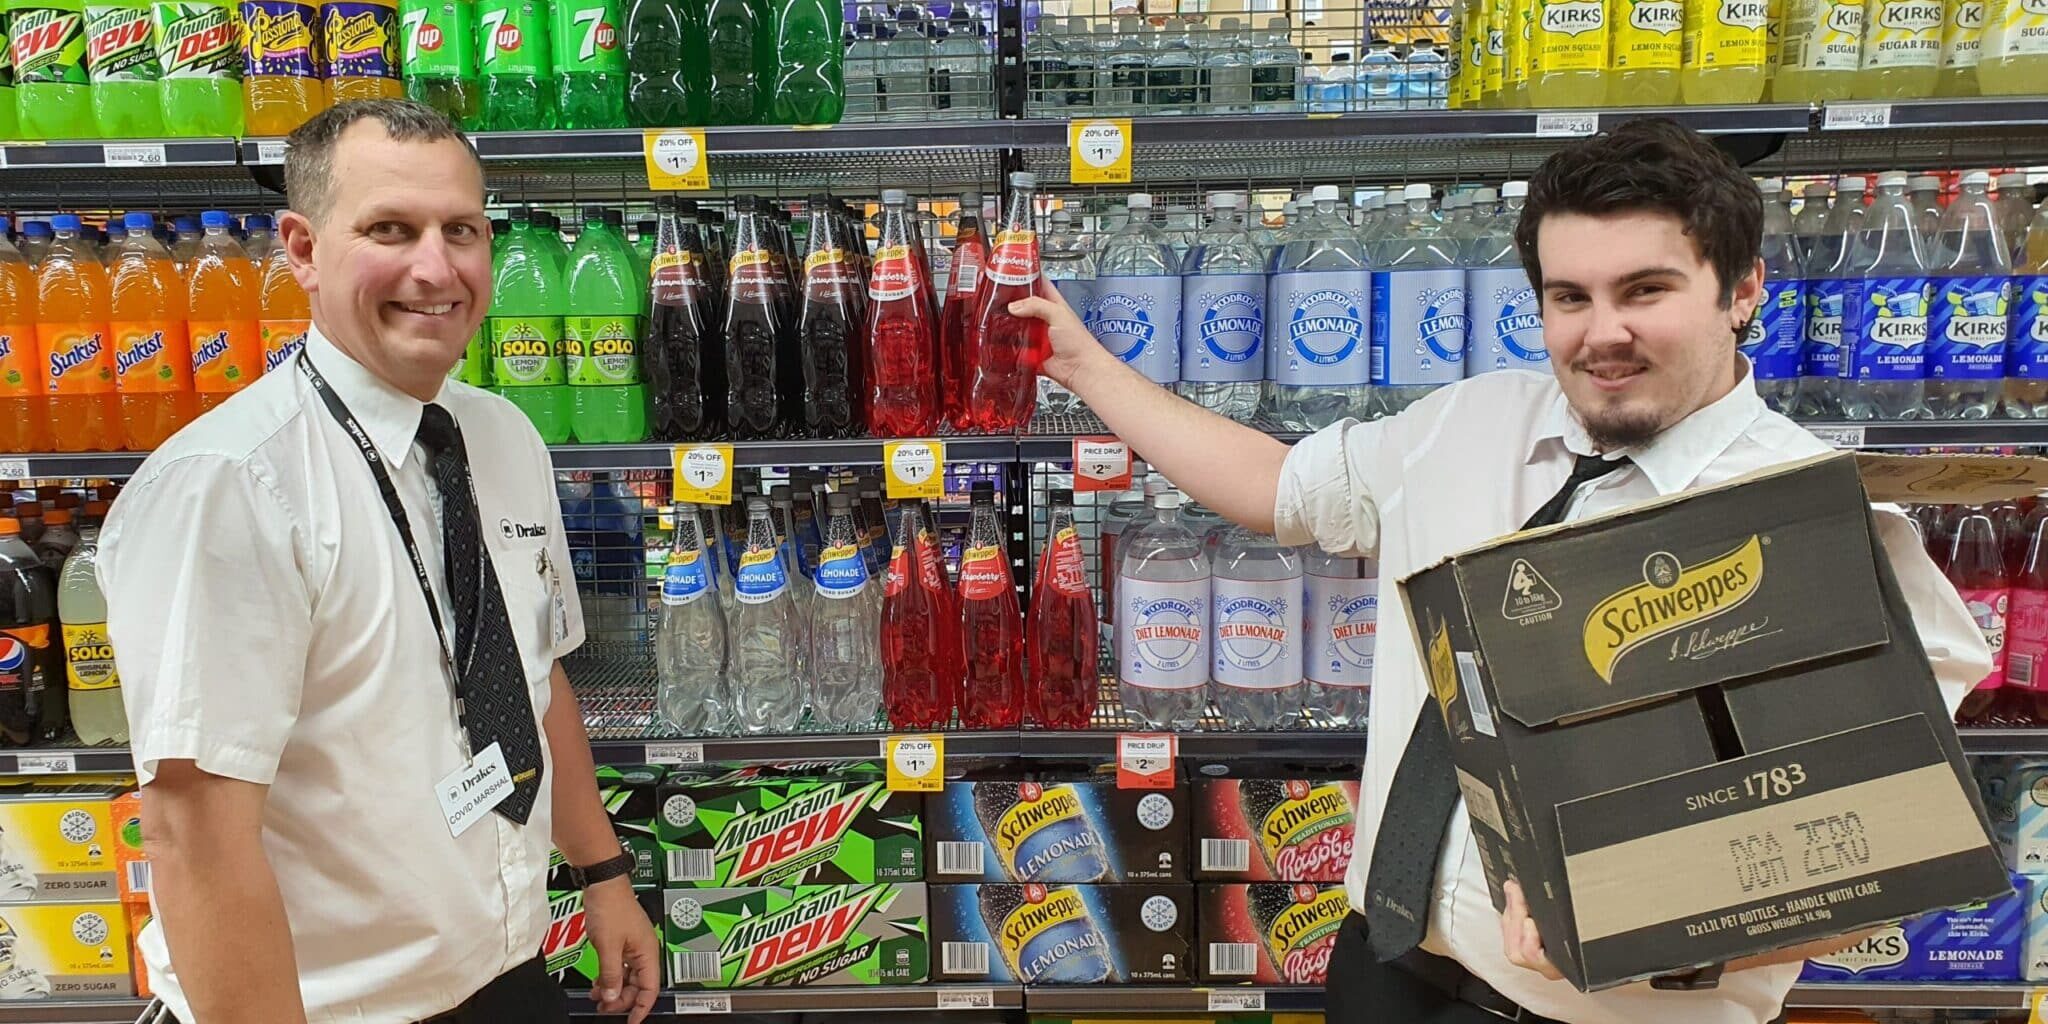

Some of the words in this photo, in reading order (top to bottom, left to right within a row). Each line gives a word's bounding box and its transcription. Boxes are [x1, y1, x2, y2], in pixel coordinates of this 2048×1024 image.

[1547, 7, 1601, 25] KIRKS
[1836, 10, 1863, 25] KIR
[1888, 6, 1941, 21] KIRKS
[252, 9, 302, 54] Passiona
[328, 11, 375, 56] Passiona
[2021, 28, 2048, 38] SUGA
[177, 22, 239, 63] Dew
[1541, 44, 1569, 53] LEMON
[1631, 43, 1659, 51] LEMON
[1879, 41, 1917, 51] SUGAR
[112, 60, 128, 71] NO
[1858, 114, 1884, 123] 2.10
[1085, 130, 1102, 138] 20%
[1103, 129, 1120, 137] OFF
[1569, 122, 1593, 132] 2.10
[659, 139, 676, 147] 20%
[677, 138, 694, 146] OFF
[1210, 294, 1258, 311] WOODROOFE
[1299, 291, 1353, 311] WOODROOFE
[1203, 318, 1263, 336] LEMONADE
[1291, 318, 1360, 336] LEMONADE
[1812, 322, 1841, 337] KIR
[1878, 322, 1927, 337] KIRKS
[1953, 322, 2006, 337] KIRKS
[51, 334, 103, 376] Sunkist
[117, 332, 163, 375] Sunkist
[503, 341, 546, 357] SOLO
[593, 340, 633, 356] SOLO
[511, 358, 540, 366] LEMON
[602, 358, 629, 366] LEMON
[1319, 354, 1339, 364] LITRES
[1877, 356, 1924, 365] LEMONADE
[1951, 354, 2002, 364] LEMONADE
[1835, 434, 1860, 443] 2.10
[688, 453, 704, 461] 20%
[705, 453, 722, 461] OFF
[897, 449, 914, 457] 20%
[915, 448, 930, 456] OFF
[516, 523, 547, 538] Drakes
[738, 573, 777, 583] LEMONADE
[820, 568, 859, 578] LEMONADE
[1143, 599, 1195, 618] WOODROOFE
[1225, 599, 1276, 618] WOODROOFE
[1602, 561, 1748, 649] Schweppes
[1519, 612, 1553, 626] CAUTION
[1136, 627, 1153, 641] DIET
[1154, 625, 1200, 642] LEMONADE
[1220, 626, 1233, 640] DIET
[1235, 624, 1285, 642] LEMONADE
[1333, 627, 1353, 641] DIET
[70, 645, 113, 661] SOLO
[1162, 659, 1180, 669] LITRES
[1242, 659, 1260, 669] LITRES
[900, 742, 916, 751] 20%
[917, 742, 932, 750] OFF
[1127, 742, 1146, 750] PRICE
[1147, 742, 1166, 750] DROP
[677, 750, 698, 760] 2.20
[461, 760, 497, 793] Drakes
[1686, 786, 1739, 811] SINCE
[1742, 763, 1808, 800] 1783
[449, 801, 474, 825] COVID
[473, 776, 509, 805] MARSHAL
[666, 795, 693, 807] FRIDGE
[1142, 795, 1169, 808] FRIDGE
[63, 811, 91, 823] FRIDGE
[666, 809, 695, 826] FRIENDLY
[723, 787, 836, 850] Mountain
[1000, 794, 1078, 851] Schweppes
[1141, 813, 1169, 830] FRIENDLY
[1267, 790, 1348, 849] Schweppes
[62, 826, 94, 842] FRIENDLY
[735, 792, 866, 880] Dew
[1019, 831, 1098, 880] LEMONADE
[1276, 830, 1353, 881] Raspbe
[763, 844, 840, 885] ENERGISED
[44, 881, 72, 890] ZERO
[73, 880, 107, 889] SUGAR
[674, 899, 699, 912] FRIDGE
[1146, 898, 1172, 910] FRIDGE
[1721, 914, 1738, 929] PET
[1740, 905, 1779, 925] BOTTLES
[1786, 894, 1827, 913] HANDLE
[1826, 888, 1854, 904] WITH
[1854, 880, 1883, 897] CARE
[76, 913, 103, 925] FRIDGE
[673, 912, 700, 929] FRIENDLY
[728, 890, 841, 955] Mountain
[1005, 895, 1083, 952] Schweppes
[1144, 914, 1174, 929] FRIENDLY
[1746, 922, 1772, 936] GROSS
[1772, 915, 1804, 931] WEIGHT:
[1804, 910, 1832, 925] 14.9kg
[75, 929, 106, 945] FRIENDLY
[742, 895, 873, 981] Dew
[1844, 935, 1902, 956] RKS
[1929, 950, 2004, 961] LEMONADE
[772, 950, 839, 982] ENERGISED
[799, 970, 822, 984] NO
[823, 945, 870, 976] SUGAR
[56, 983, 81, 991] ZERO
[83, 981, 117, 990] SUGAR
